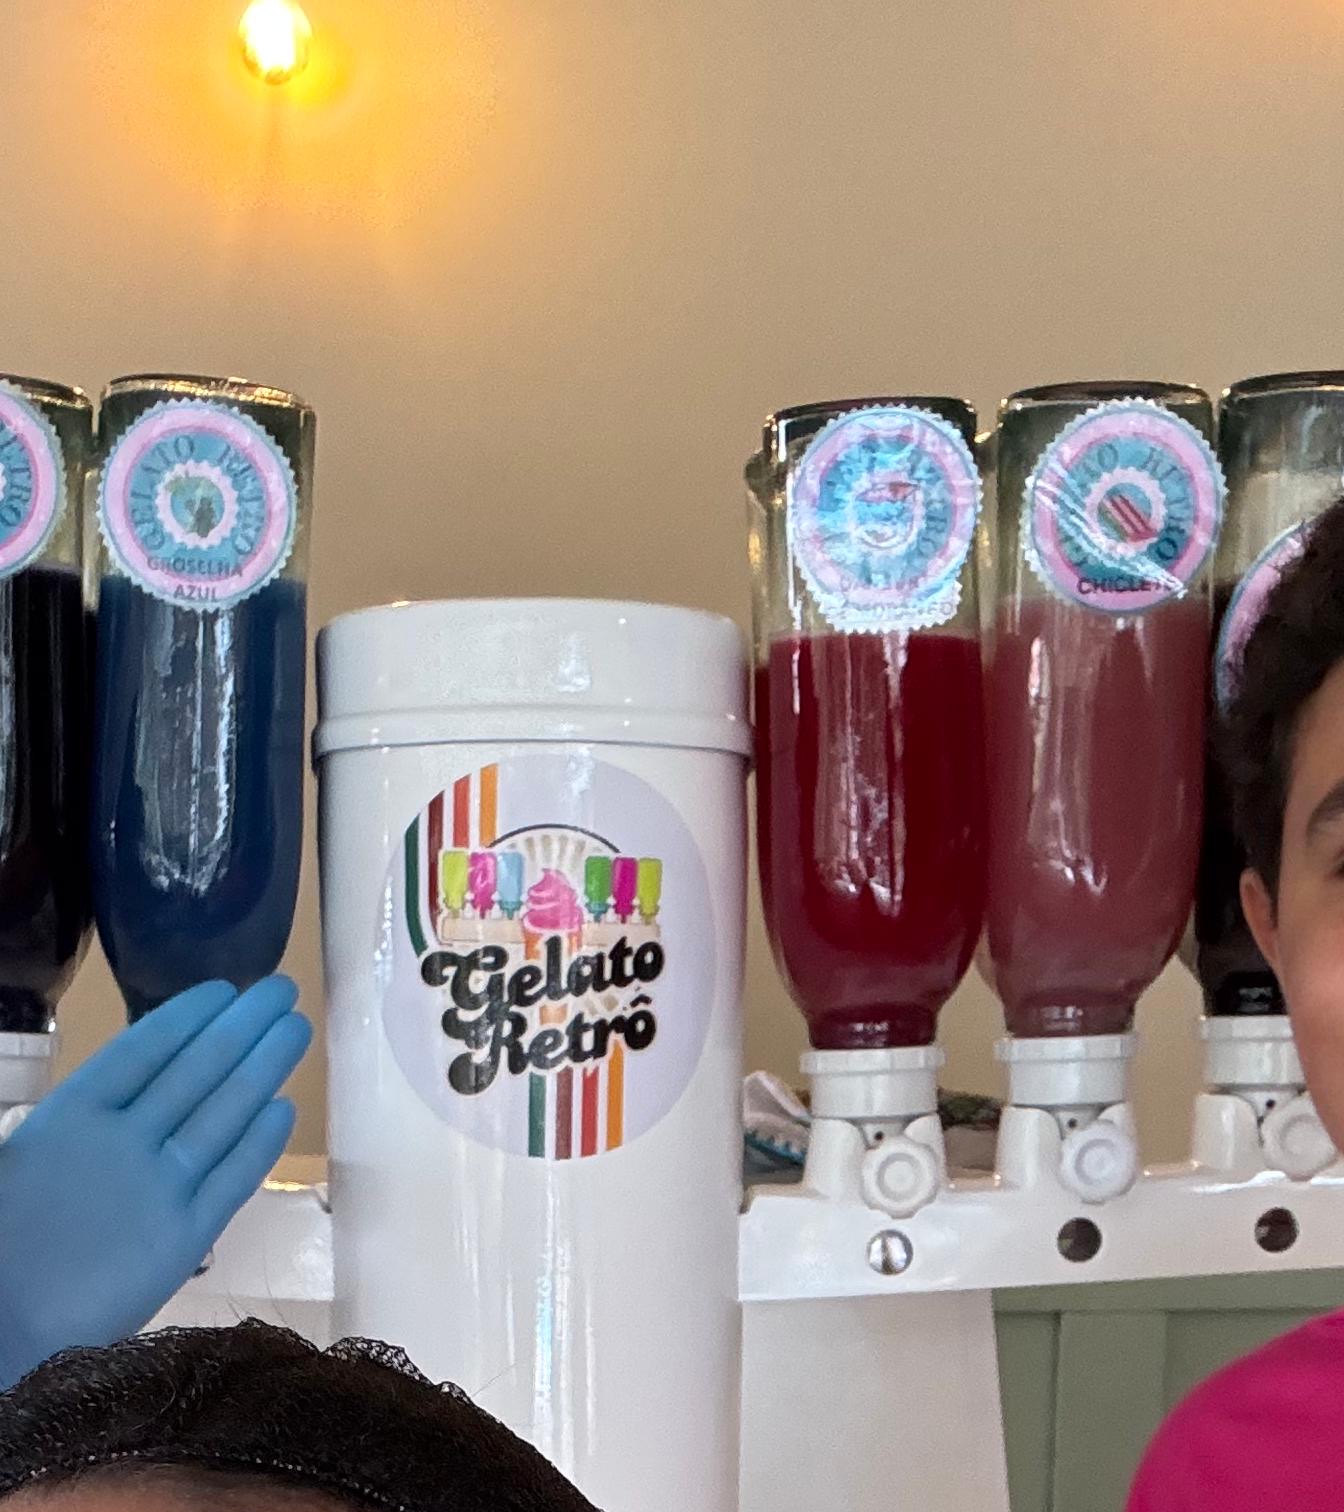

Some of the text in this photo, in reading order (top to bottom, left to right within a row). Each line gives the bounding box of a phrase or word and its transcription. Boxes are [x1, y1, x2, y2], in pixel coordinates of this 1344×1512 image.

[131, 434, 195, 550] GELATO
[147, 556, 244, 577] GROSELHA
[174, 584, 217, 600] AZUL
[421, 935, 664, 1011] Gelato
[441, 993, 656, 1095] Retrô
